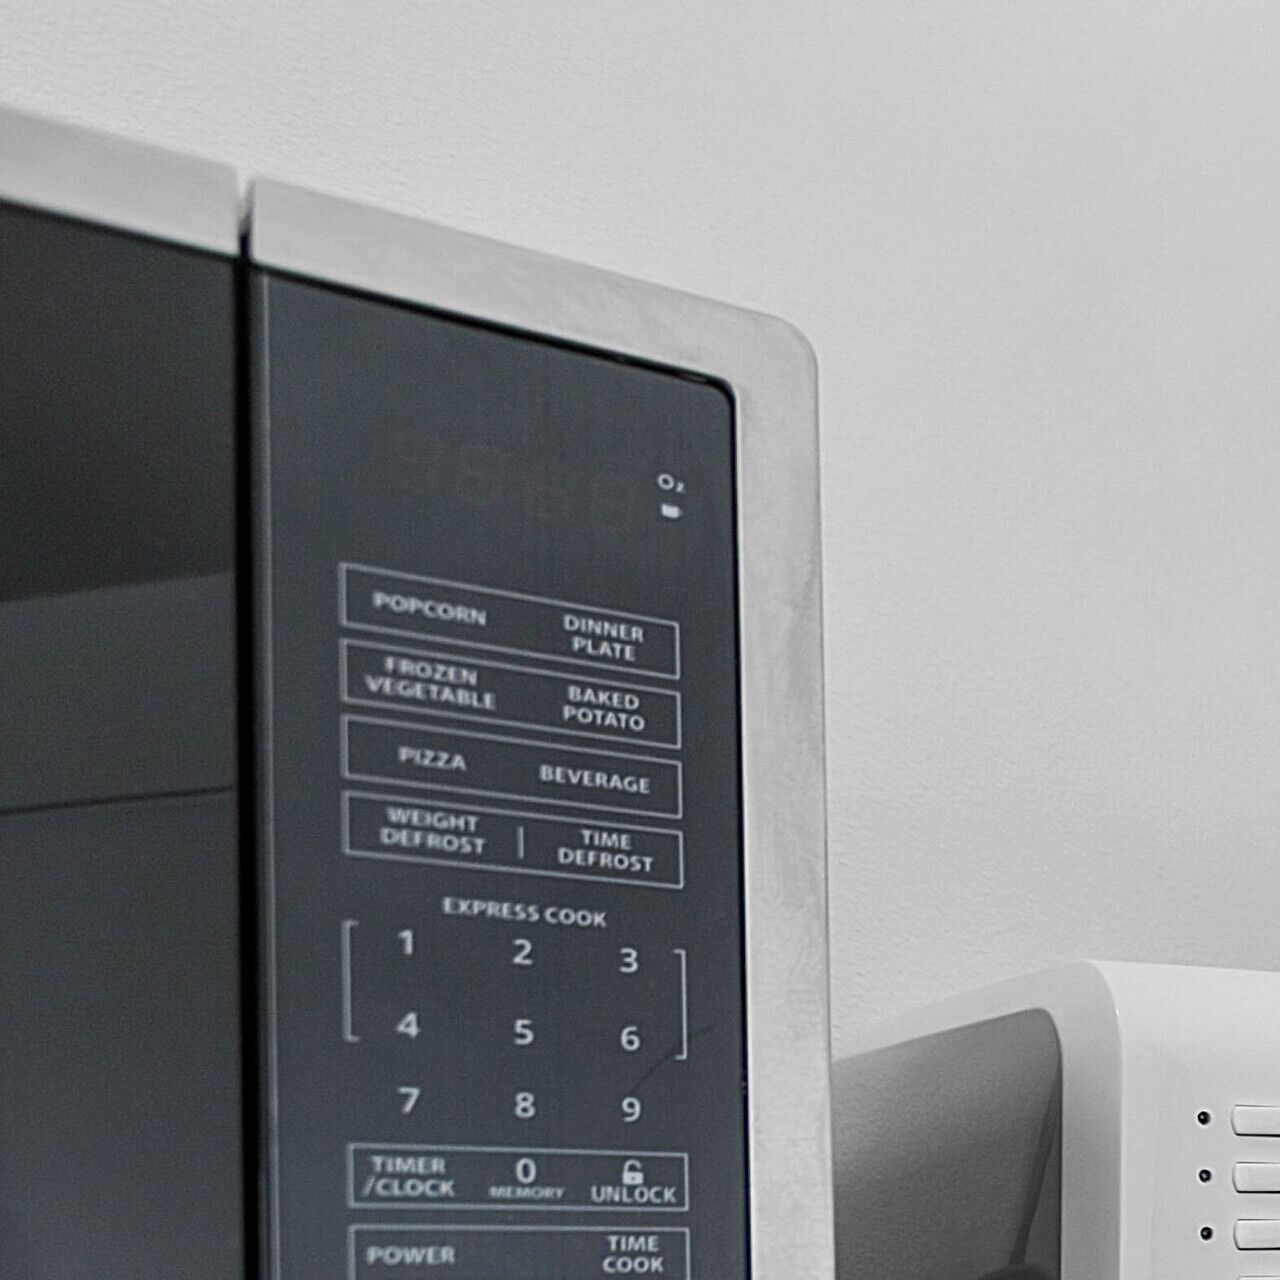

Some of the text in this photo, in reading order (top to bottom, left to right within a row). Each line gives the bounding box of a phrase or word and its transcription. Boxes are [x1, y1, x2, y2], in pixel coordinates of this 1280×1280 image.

[373, 591, 487, 627] POPCORN
[562, 613, 644, 643] DINNER
[571, 637, 636, 662] PLATE
[384, 656, 477, 685] FROZEN
[365, 674, 496, 710] VEGETABLE
[567, 685, 639, 711] BAKED
[562, 705, 645, 732] POTATO
[398, 745, 466, 771] PIZZA
[539, 765, 650, 794] BEVERAGE
[386, 806, 479, 833] WEIGHT
[380, 828, 485, 855] DEFROST
[581, 829, 632, 849] TIME
[558, 847, 654, 873] DEFROST
[442, 897, 607, 928] EXPRESS COOK
[399, 930, 414, 955] 1
[513, 938, 533, 966] 2
[619, 948, 639, 972] 3
[396, 1012, 421, 1038] 4
[513, 1020, 534, 1045] 5
[620, 1027, 640, 1050] 6
[398, 1087, 421, 1114] 7
[514, 1092, 536, 1118] 8
[621, 1097, 641, 1122] 9
[371, 1155, 446, 1174] TIMER
[515, 1157, 536, 1184] 0
[363, 1175, 455, 1198] /CLOCK
[489, 1185, 566, 1200] MEMORY
[591, 1185, 677, 1204] UNLOCK
[366, 1246, 456, 1265] POWER
[607, 1235, 659, 1253] TIME
[603, 1254, 664, 1274] COOK
